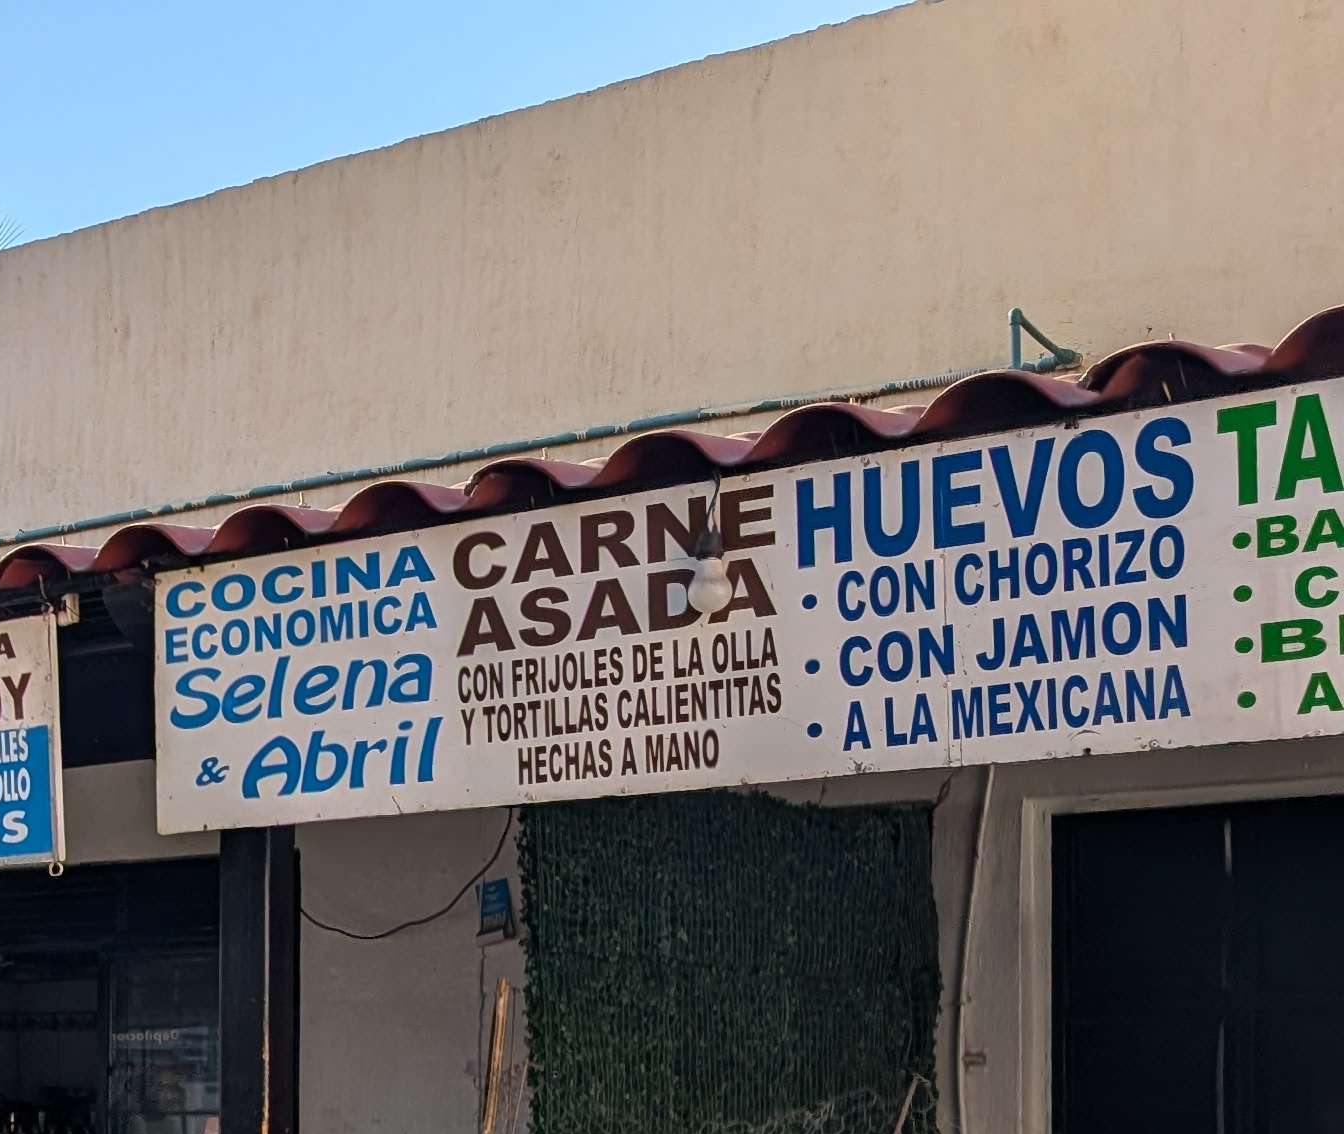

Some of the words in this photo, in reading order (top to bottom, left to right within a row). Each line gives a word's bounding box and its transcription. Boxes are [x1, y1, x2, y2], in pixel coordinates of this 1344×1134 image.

[1217, 393, 1344, 507] TA
[795, 417, 1195, 569] HUEVOS
[452, 485, 777, 591] CARNE
[837, 559, 937, 622] CON
[954, 524, 1186, 606] CHORIZO
[1256, 508, 1344, 559] BA
[165, 545, 437, 619] COCINA
[456, 558, 778, 657] ASADA
[165, 592, 438, 664] ECONOMICA
[458, 662, 503, 704] CON
[511, 644, 624, 698] FRIJOLES
[632, 640, 664, 682] DE
[673, 637, 705, 680] LA
[712, 627, 778, 676] OLLA
[839, 624, 955, 687] CON
[976, 594, 1187, 673] JAMON
[1261, 614, 1344, 663] B
[169, 653, 432, 730] Selena
[461, 708, 475, 745] Y
[483, 692, 610, 742] TORTILLAS
[616, 672, 783, 729] CALIENTITAS
[842, 700, 871, 751] A
[885, 693, 938, 748] LA
[952, 664, 1191, 740] MEXICANA
[195, 756, 230, 787] &
[241, 716, 444, 799] Abril
[517, 743, 613, 786] HECHAS
[620, 738, 638, 777] A
[645, 730, 720, 774] MANO
